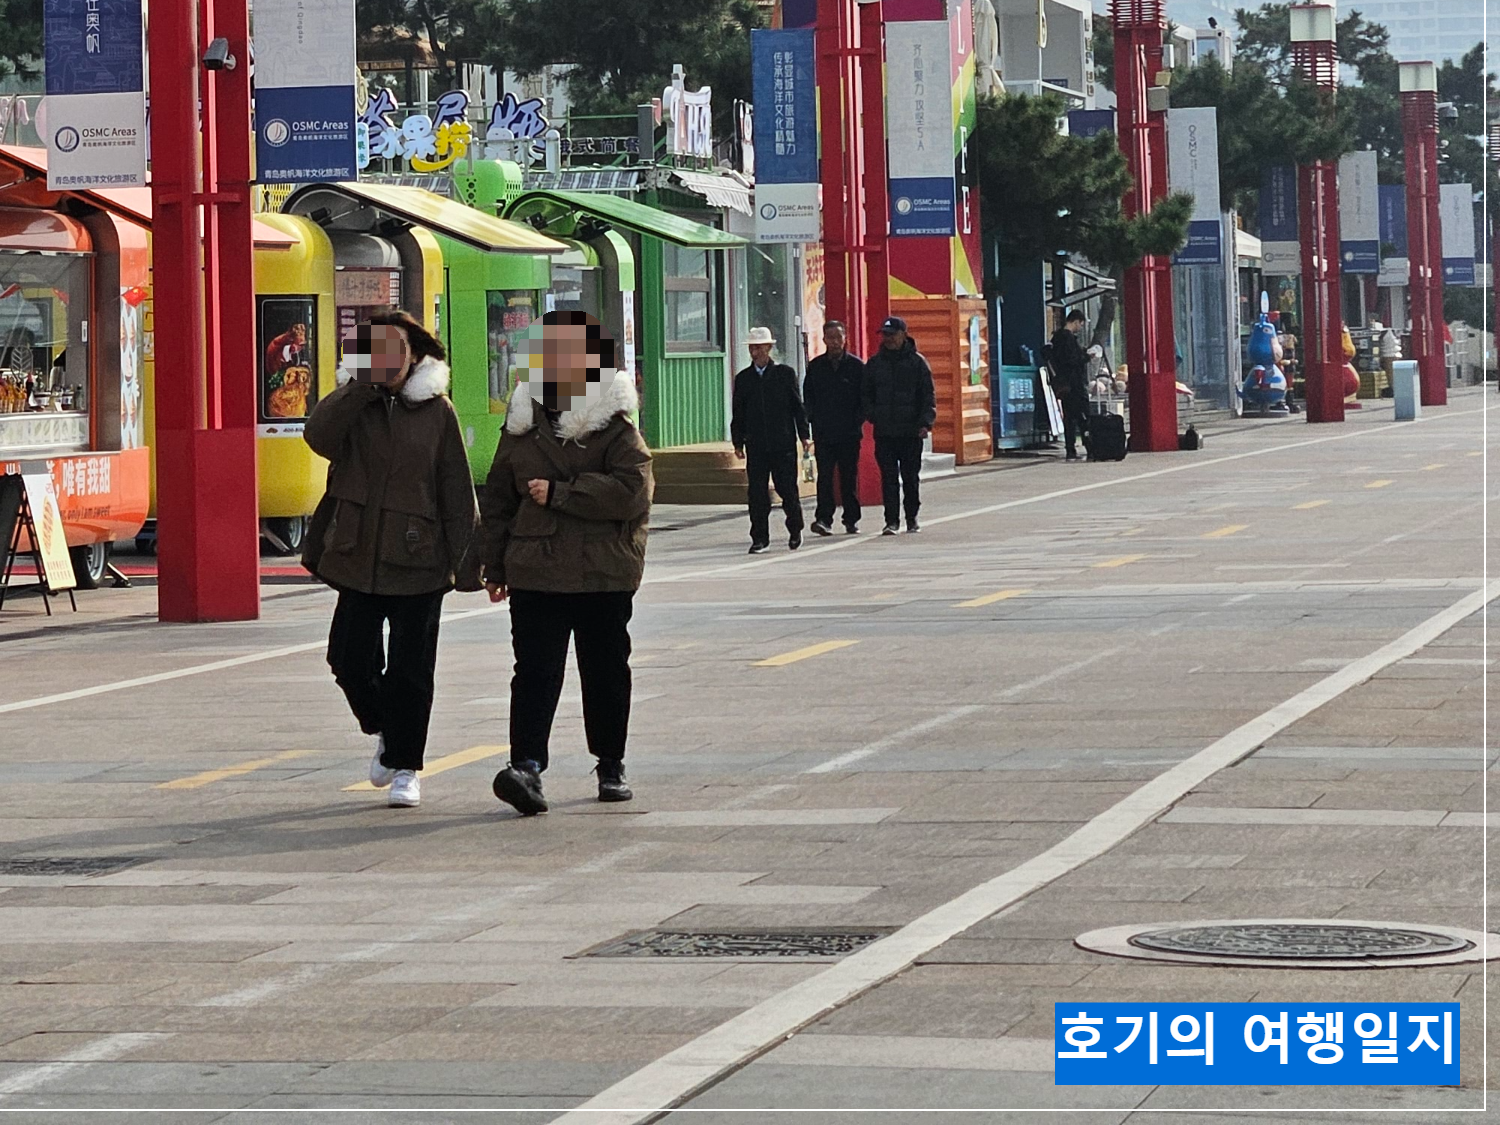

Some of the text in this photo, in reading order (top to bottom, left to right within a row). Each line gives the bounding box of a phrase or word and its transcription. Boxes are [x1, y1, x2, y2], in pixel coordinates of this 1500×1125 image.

[292, 120, 349, 131] OSMC Areas
[82, 127, 137, 138] OSMC Areas
[373, 115, 473, 172] 水果捞
[265, 167, 349, 179] 青岛奥帆海洋文化旅游区
[55, 174, 137, 185] 青岛奥帆海洋文化旅游区
